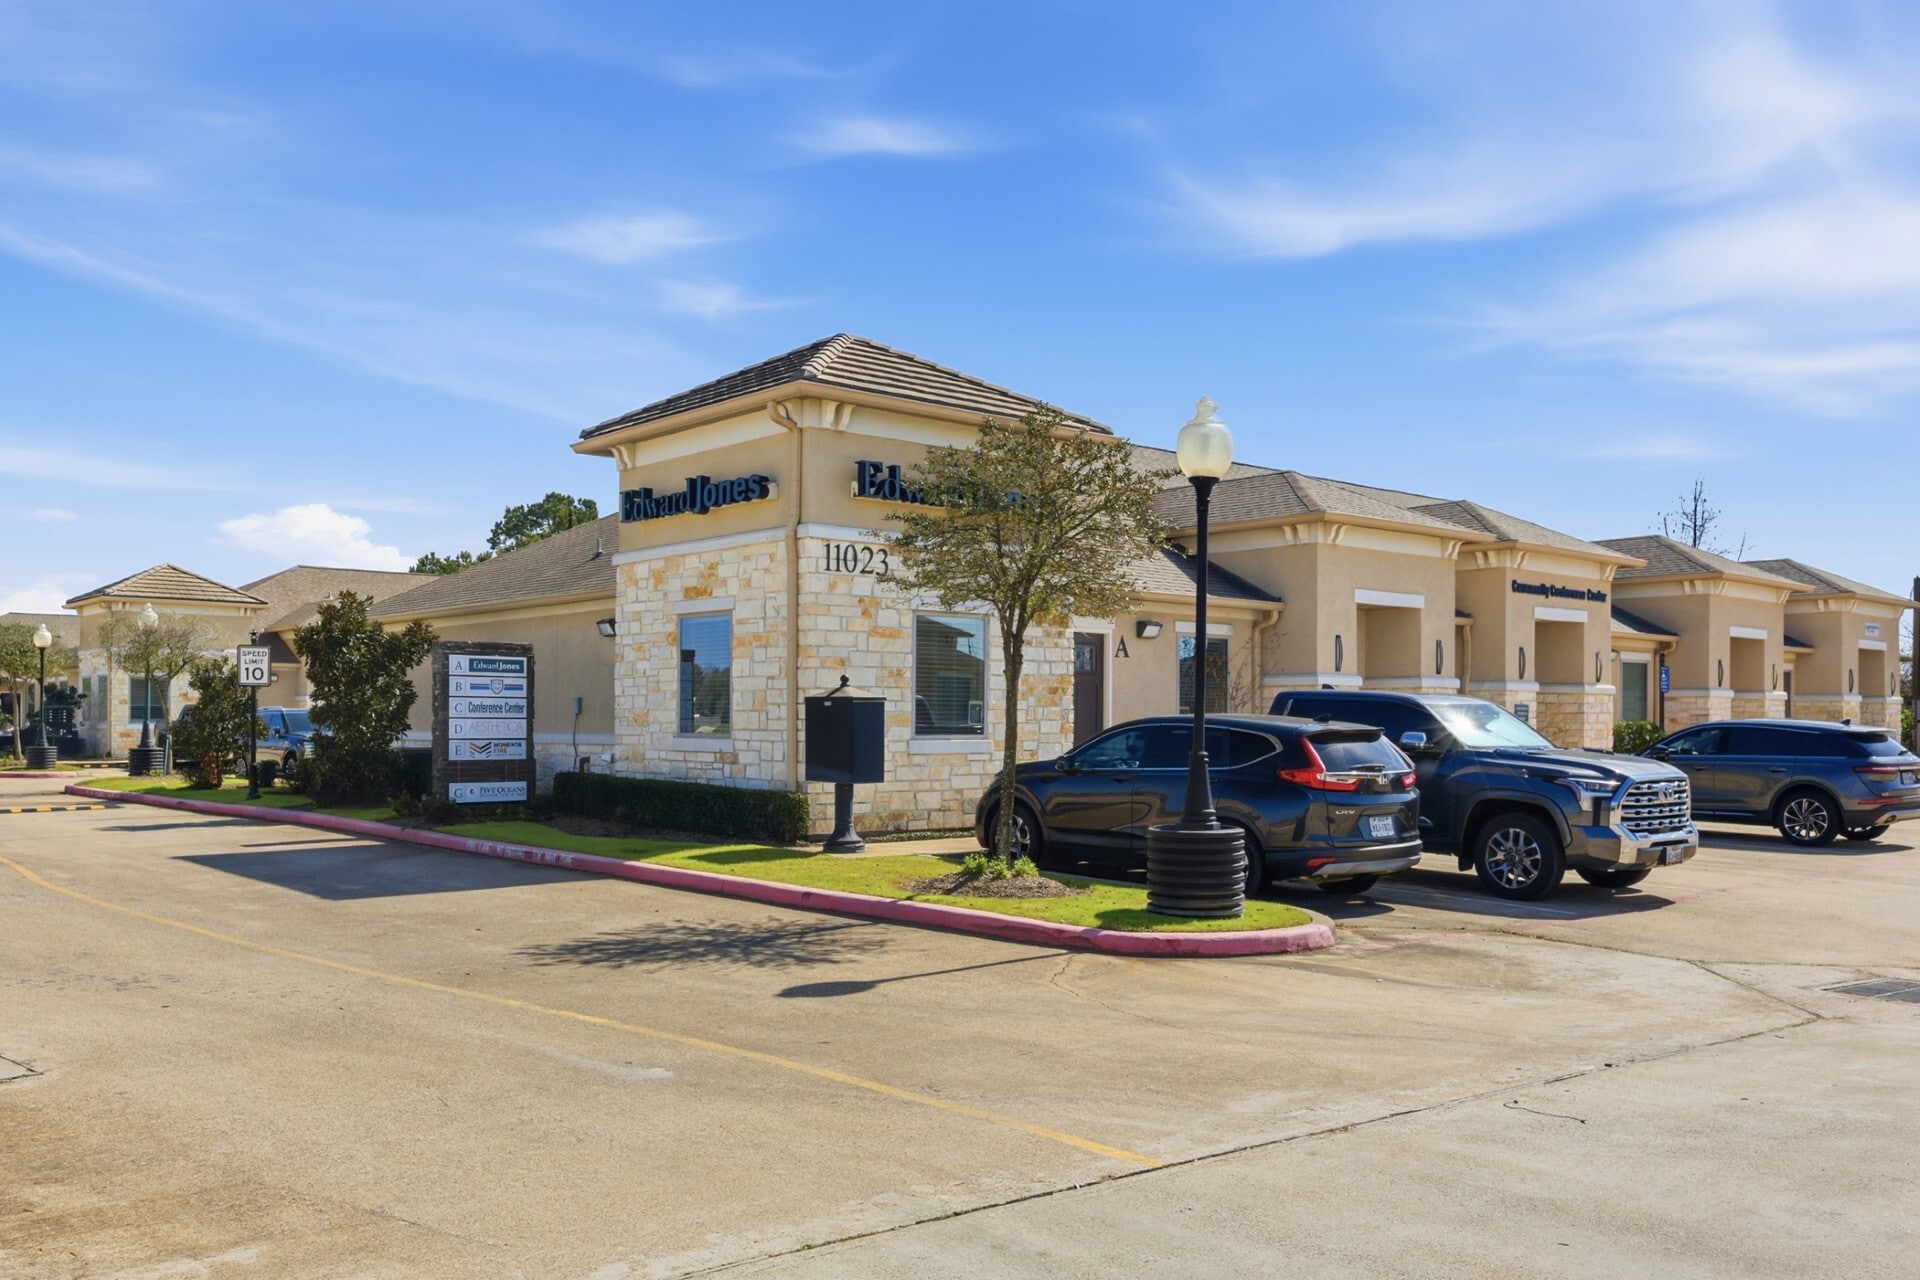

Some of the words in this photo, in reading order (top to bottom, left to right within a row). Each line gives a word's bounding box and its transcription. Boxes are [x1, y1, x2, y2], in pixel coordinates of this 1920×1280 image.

[824, 543, 889, 576] 11023
[1114, 634, 1130, 658] A
[455, 661, 463, 670] A
[244, 667, 264, 681] 10
[455, 682, 462, 691] B
[454, 703, 463, 713] C
[468, 701, 503, 713] Conference
[505, 702, 525, 714] Center
[454, 724, 463, 734] D
[469, 721, 523, 733] AESTHETICA
[455, 745, 462, 756] E
[453, 788, 463, 798] G
[480, 786, 496, 794] FIVE
[496, 785, 525, 794] OCEANS
